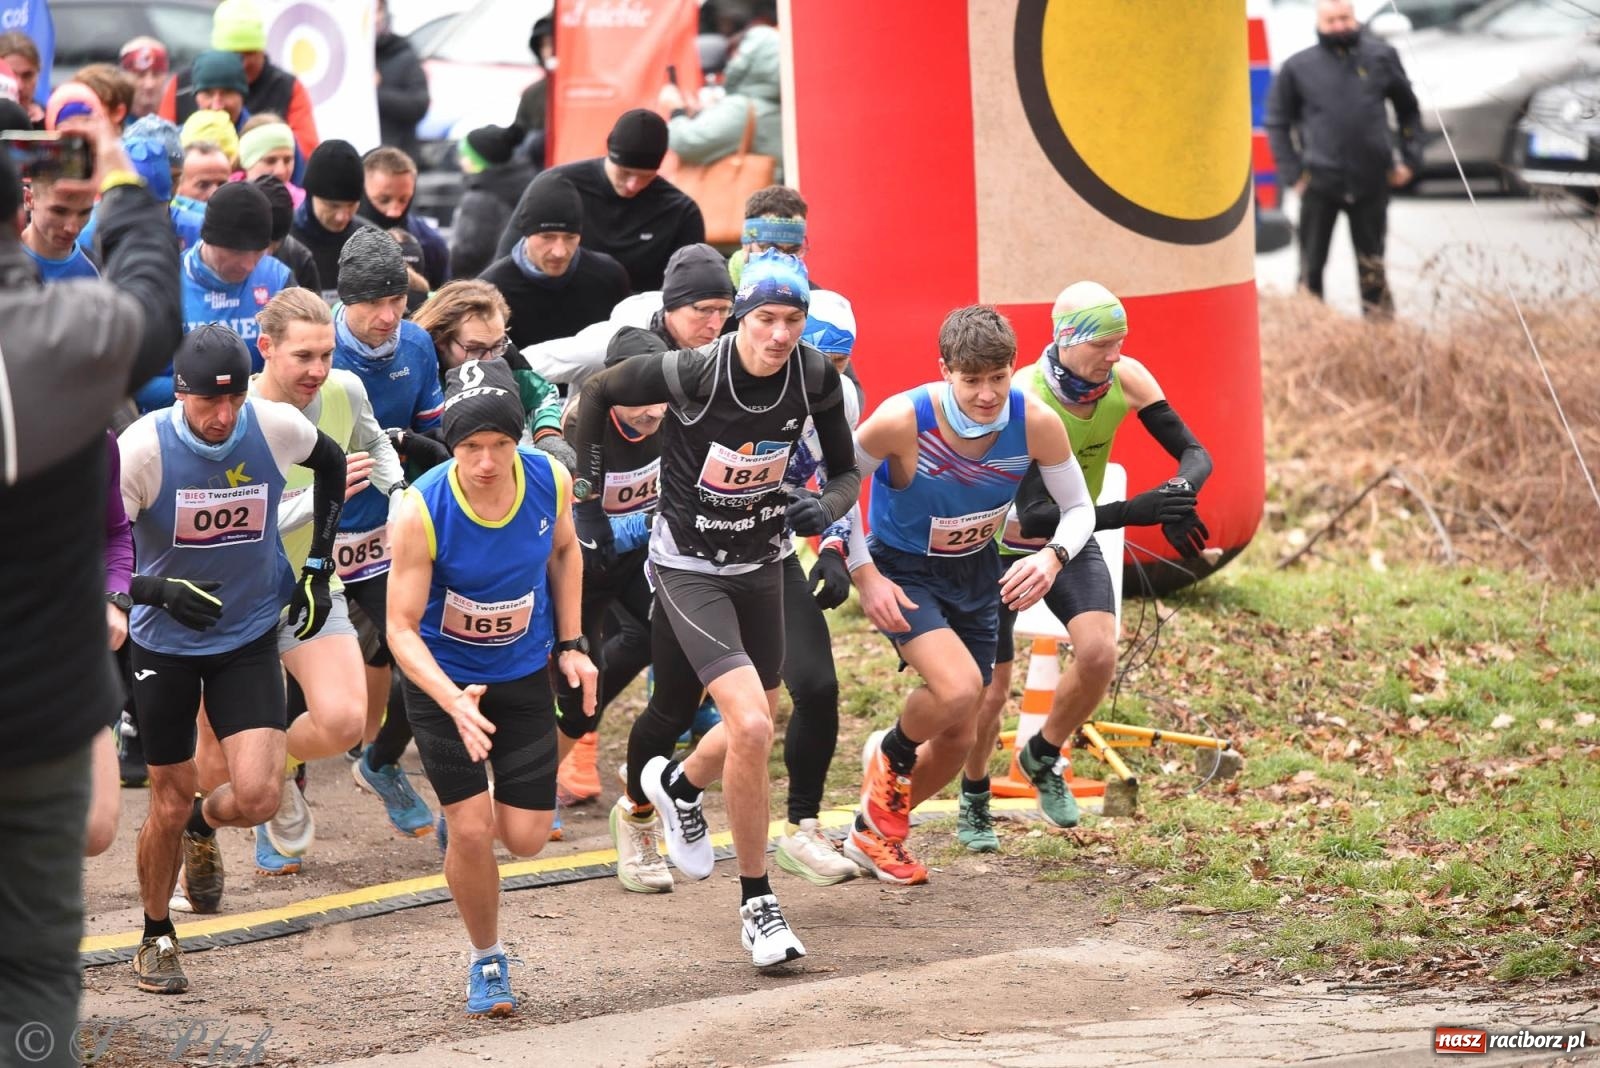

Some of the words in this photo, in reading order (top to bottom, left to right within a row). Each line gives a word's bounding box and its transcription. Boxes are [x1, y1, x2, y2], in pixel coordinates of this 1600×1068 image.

[719, 448, 738, 460] BIEG
[723, 466, 770, 485] 184
[184, 492, 206, 500] BIEG
[208, 488, 260, 499] Twardziela
[194, 506, 250, 532] 002
[695, 514, 756, 533] RUNNERS
[947, 523, 994, 546] 226
[338, 538, 384, 567] 085
[453, 595, 473, 608] BIEG
[475, 599, 527, 611] Twardziela
[463, 614, 513, 634] 165
